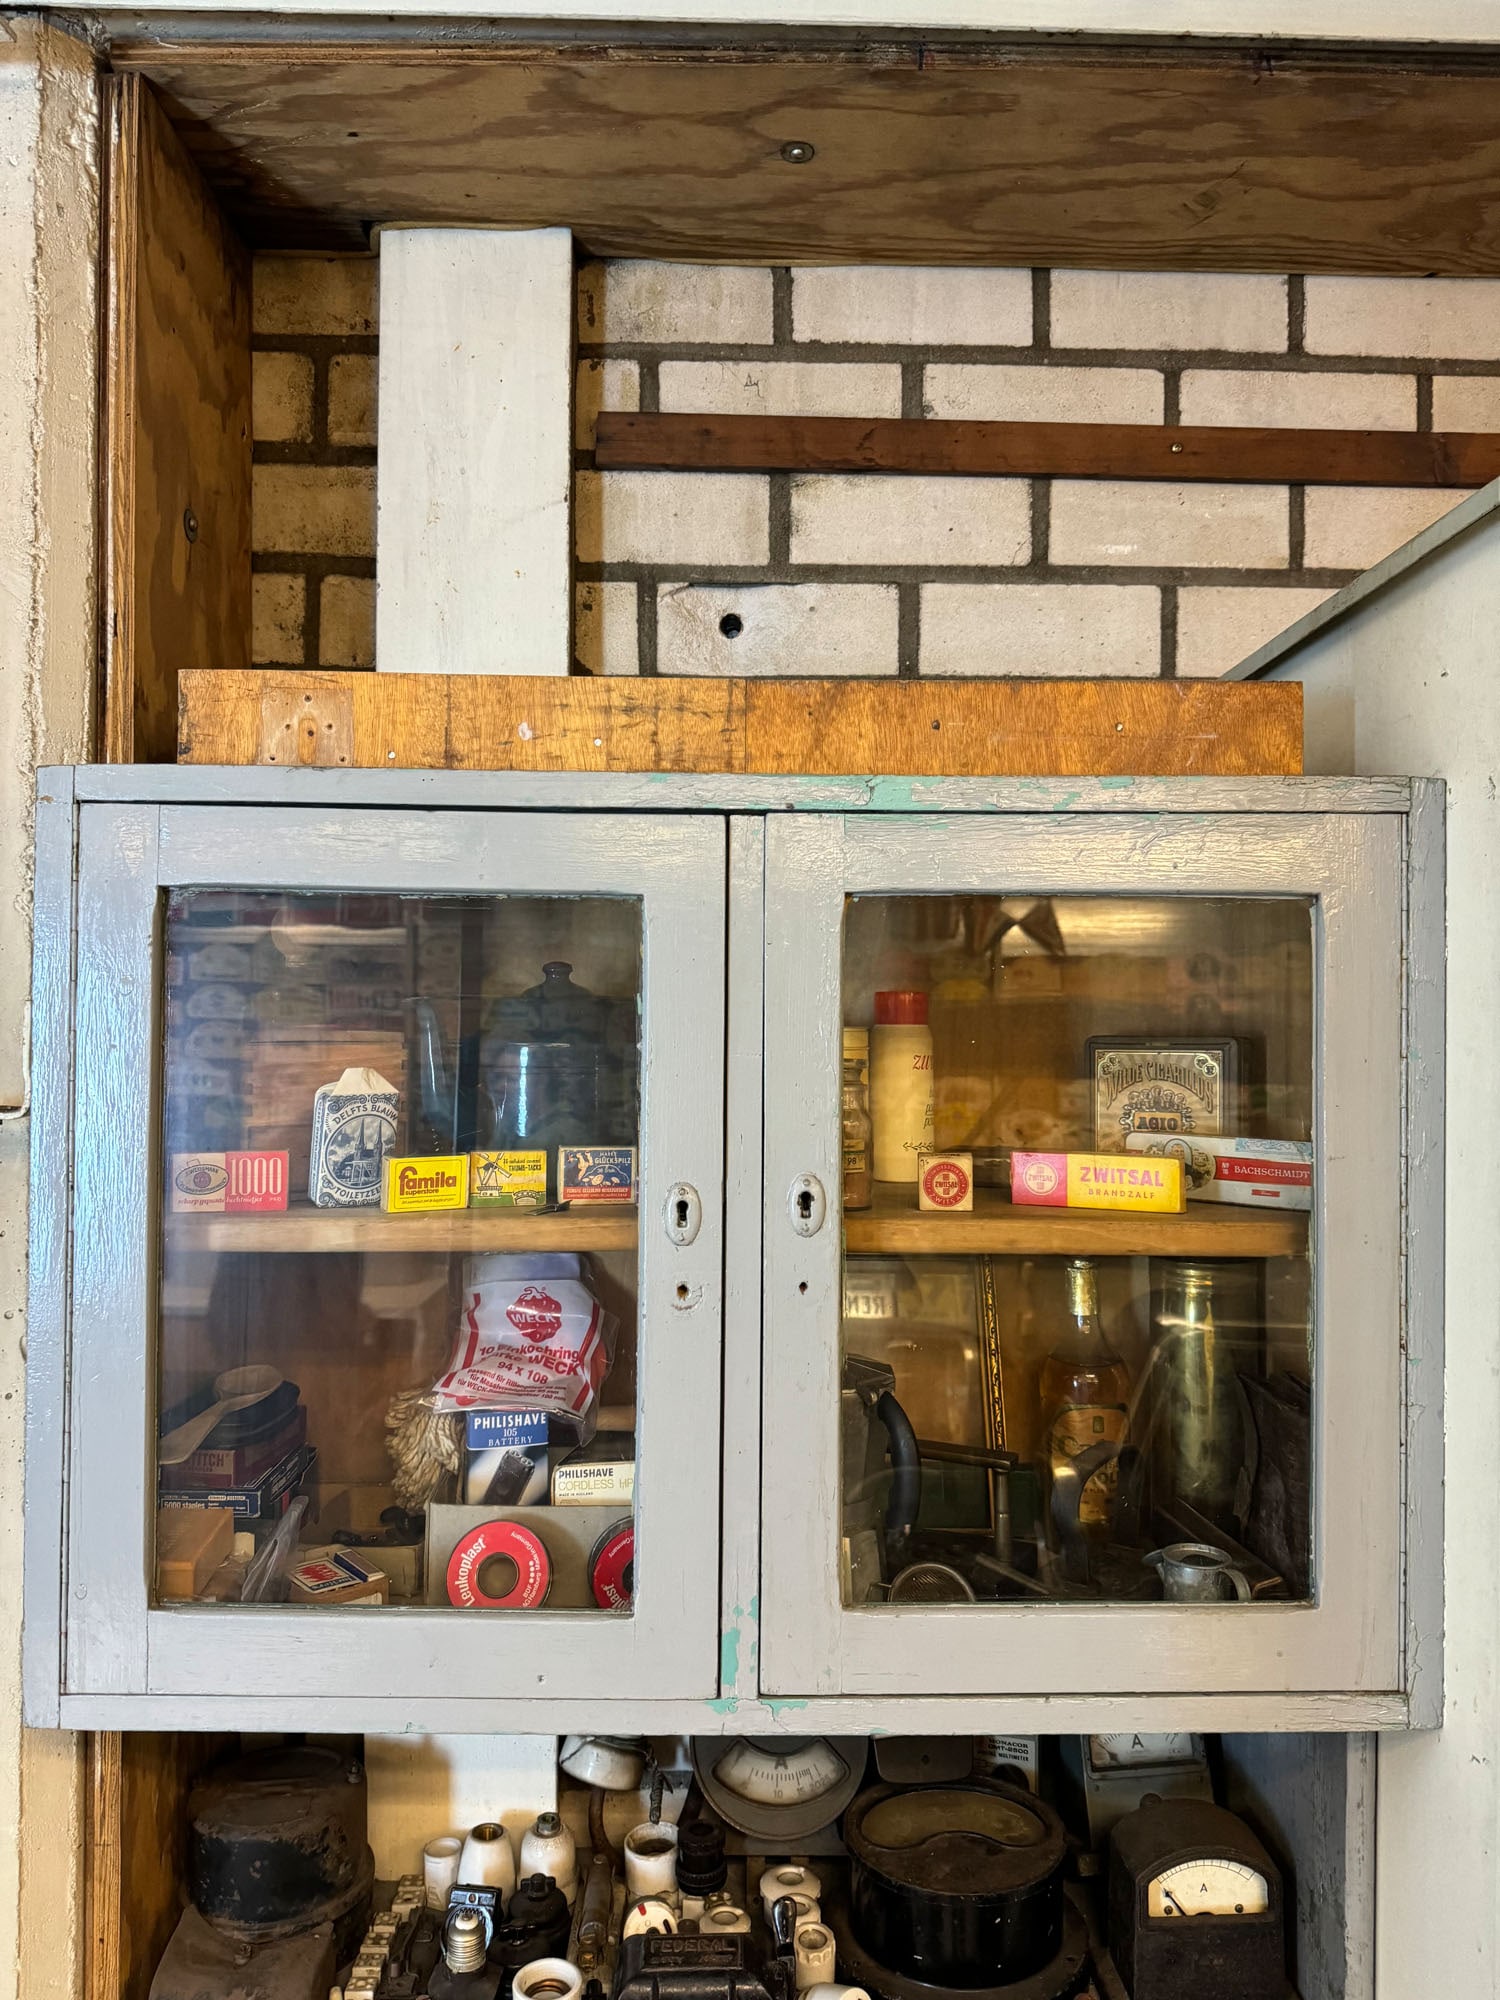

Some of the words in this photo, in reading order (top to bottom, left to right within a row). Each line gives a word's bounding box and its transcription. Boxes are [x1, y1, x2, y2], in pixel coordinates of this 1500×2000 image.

[1103, 1063, 1143, 1111] WILDE
[1145, 1061, 1214, 1114] CIGARILLOS
[332, 1105, 368, 1125] DELFTS
[370, 1104, 398, 1121] BLAUW
[1136, 1116, 1178, 1131] AGIO
[594, 1156, 632, 1164] GLÜCKSPILZ
[230, 1157, 282, 1196] 1000
[1080, 1166, 1164, 1187] ZWITSAL
[1234, 1165, 1311, 1179] BACHSCHMIDT
[398, 1166, 457, 1196] famila
[335, 1185, 381, 1199] TOILETZEE
[405, 1188, 440, 1196] superstore
[1088, 1189, 1156, 1200] BRANDZALF
[510, 1312, 558, 1324] WECK
[528, 1355, 580, 1376] WECK
[497, 1361, 513, 1371] 94
[527, 1369, 549, 1385] 108
[474, 1412, 547, 1430] PHILISHAVE
[503, 1428, 518, 1437] 105
[488, 1436, 533, 1447] BATTERY
[558, 1467, 614, 1479] PHILISHAVE
[558, 1479, 615, 1491] CORDLESS
[454, 1537, 487, 1607] Leukoplast
[988, 1738, 1029, 1749] MONACOR
[1131, 1733, 1145, 1749] A
[773, 1790, 783, 1798] 10
[1199, 1883, 1208, 1893] A
[649, 1939, 737, 1953] FEDERAL
